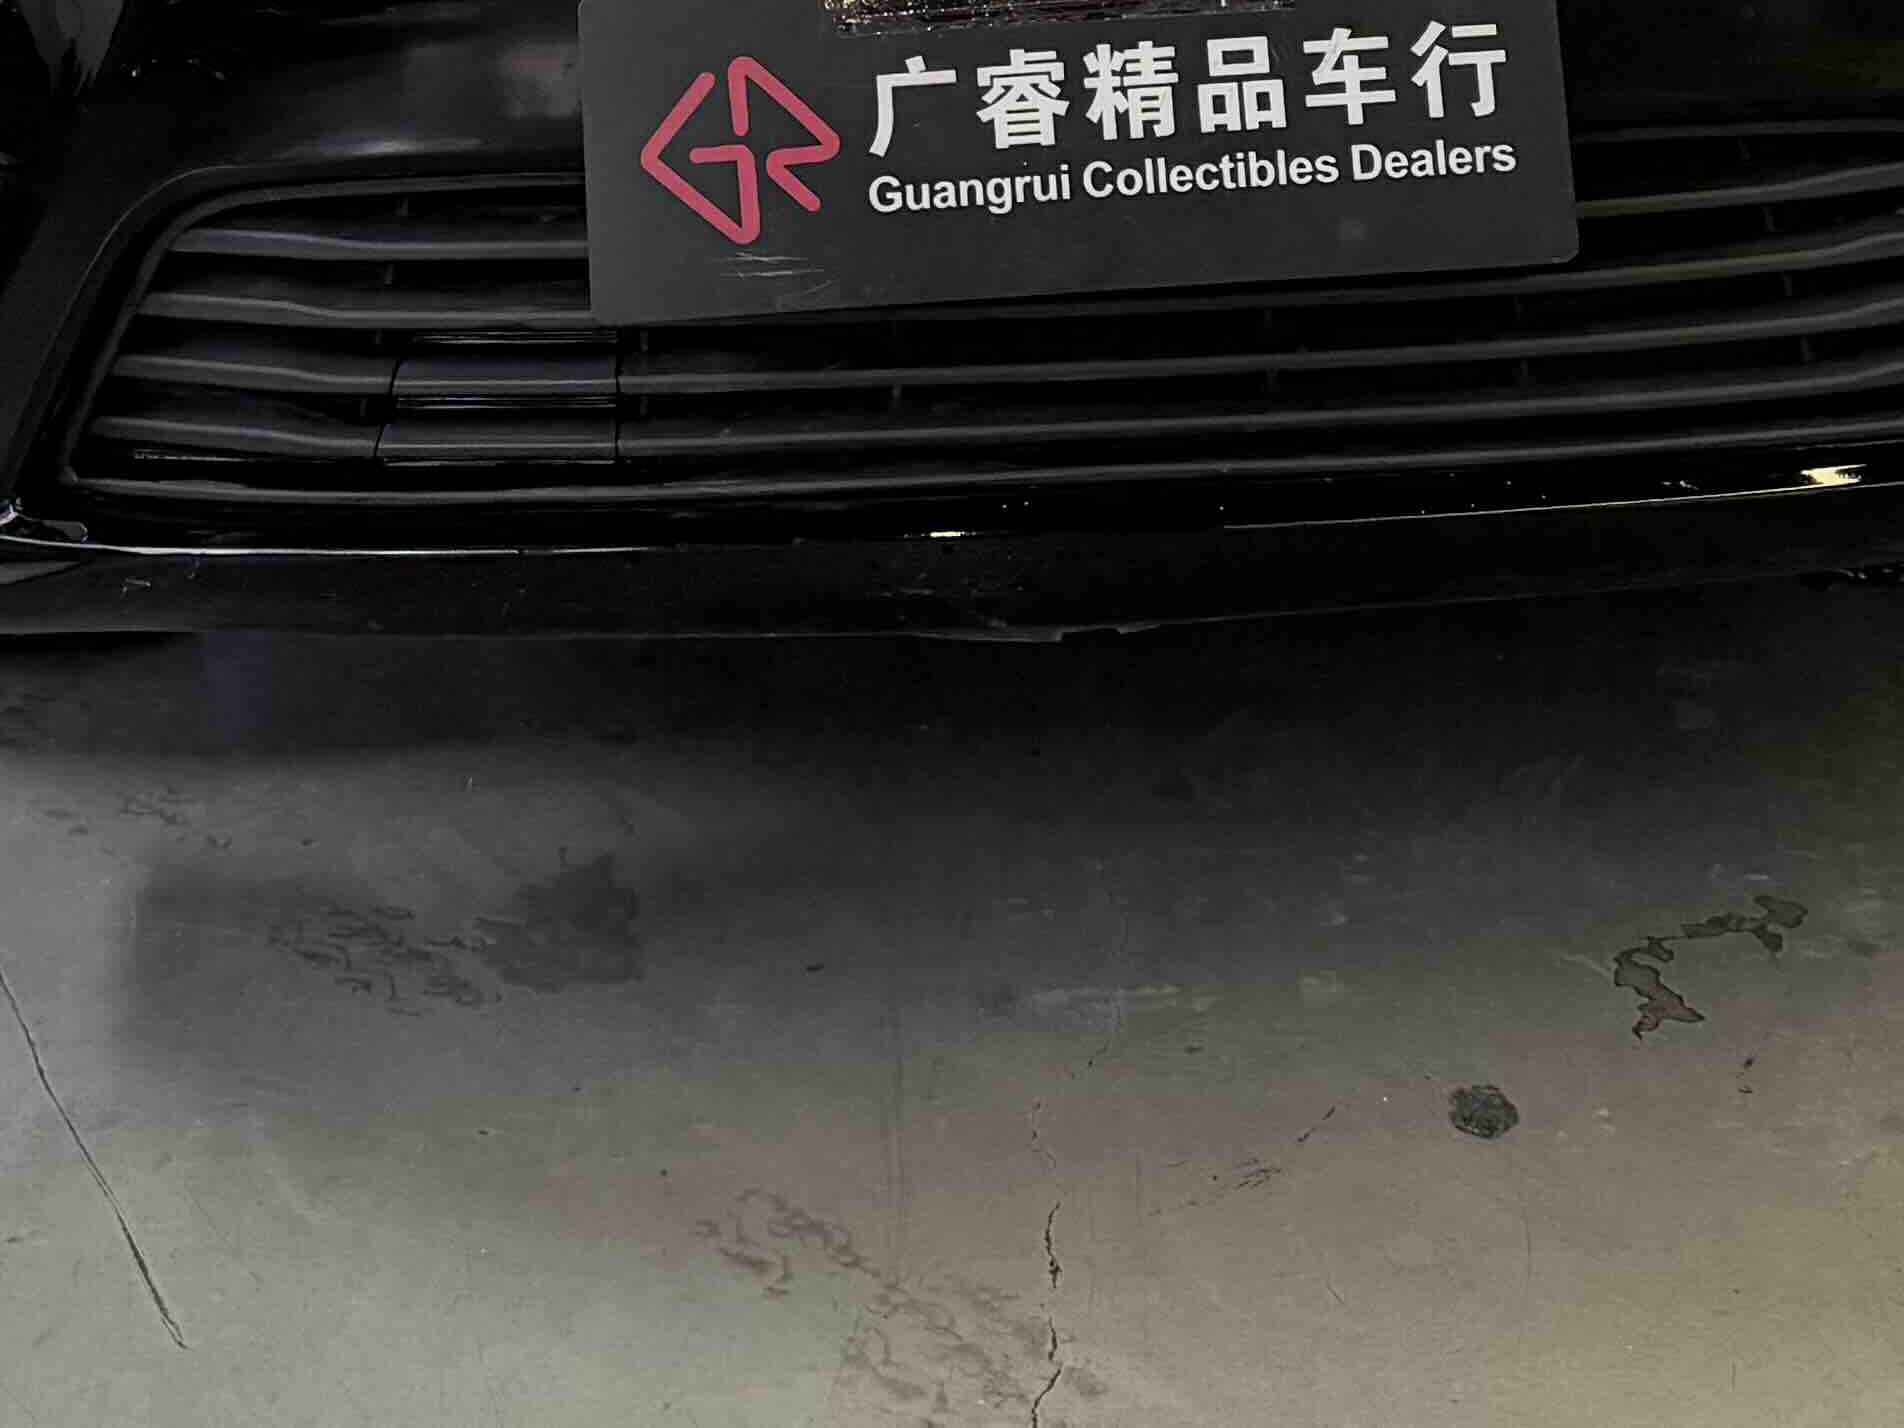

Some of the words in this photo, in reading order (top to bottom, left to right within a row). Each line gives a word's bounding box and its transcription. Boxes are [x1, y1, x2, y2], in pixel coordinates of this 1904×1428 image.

[868, 20, 1508, 158] 广睿精品车行
[867, 168, 1072, 214] Guangrui
[1082, 153, 1340, 199] Collectibles
[1350, 138, 1517, 181] Dealers
